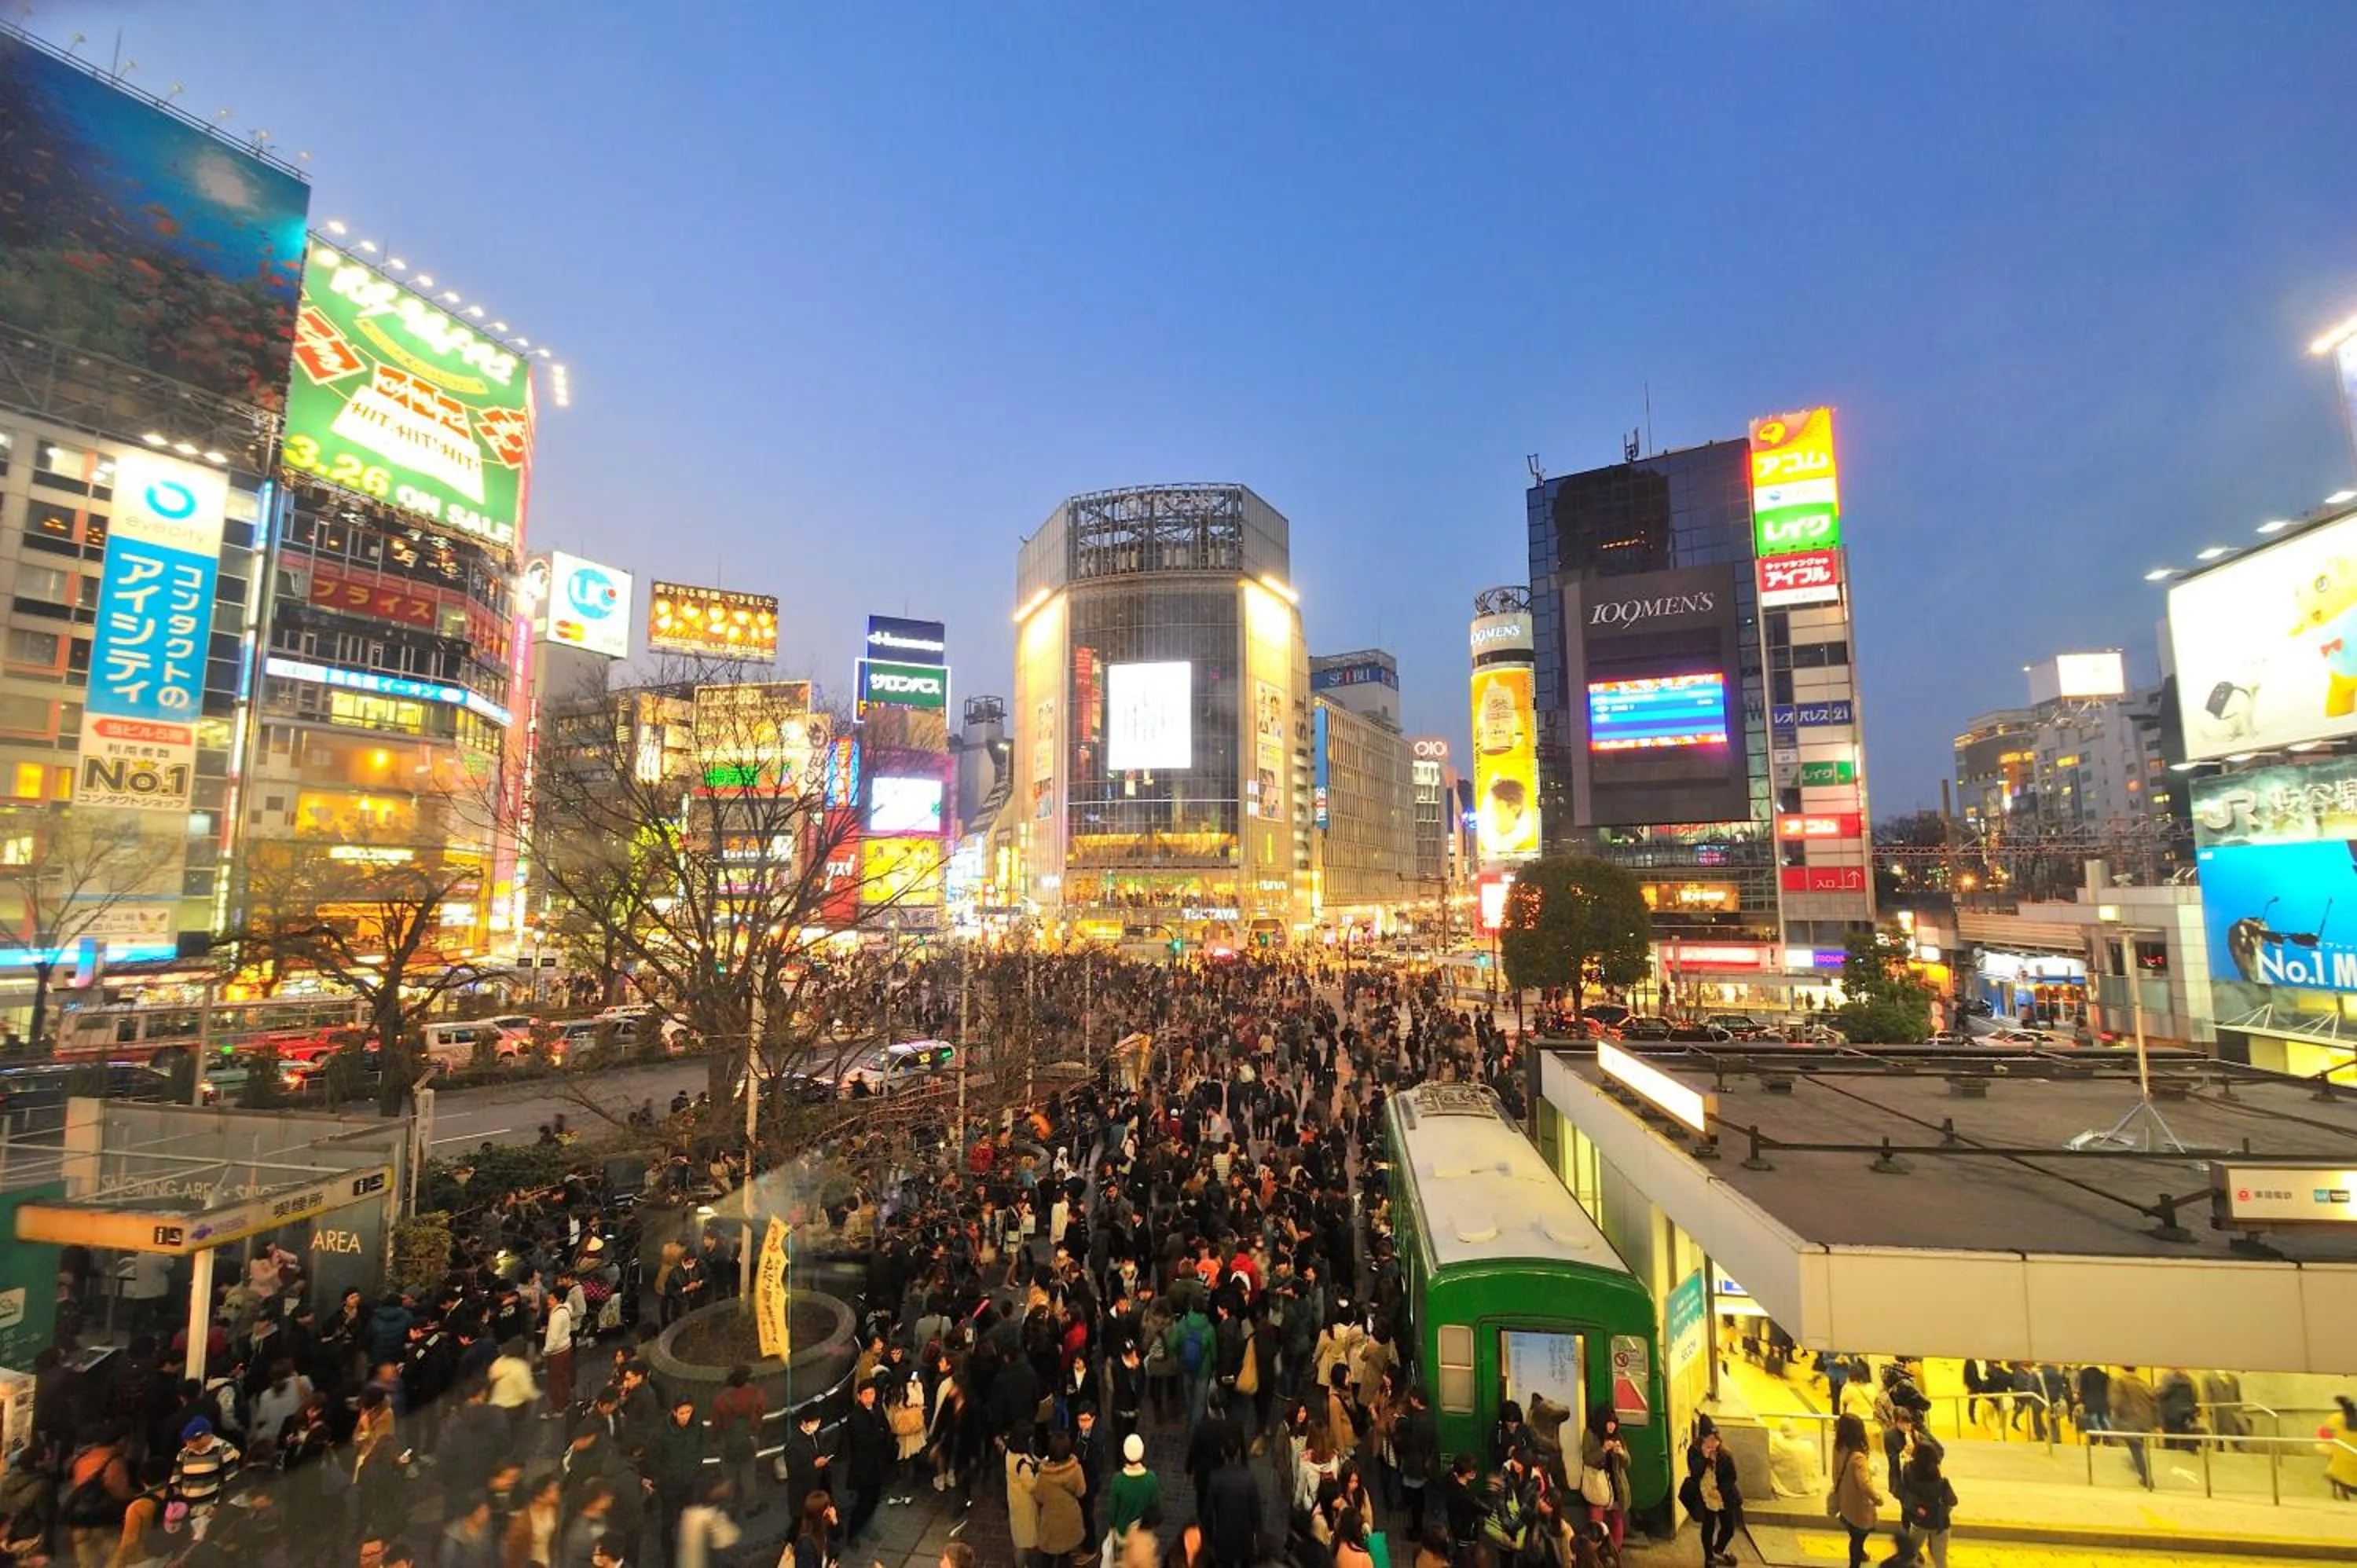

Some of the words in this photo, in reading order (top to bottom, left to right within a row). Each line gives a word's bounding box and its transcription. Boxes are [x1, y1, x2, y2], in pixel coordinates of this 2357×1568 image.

[1757, 451, 1829, 476] アコム
[280, 434, 391, 498] 3.26
[395, 484, 442, 518] ON
[445, 503, 514, 544] SALE
[1763, 514, 1831, 542] レイク
[1765, 566, 1831, 588] アイフル
[106, 552, 164, 704] アイシティ
[159, 564, 203, 709] コンタクトの
[80, 754, 191, 797] No.1
[2255, 948, 2326, 985] No.1
[311, 1228, 361, 1255] AREA
